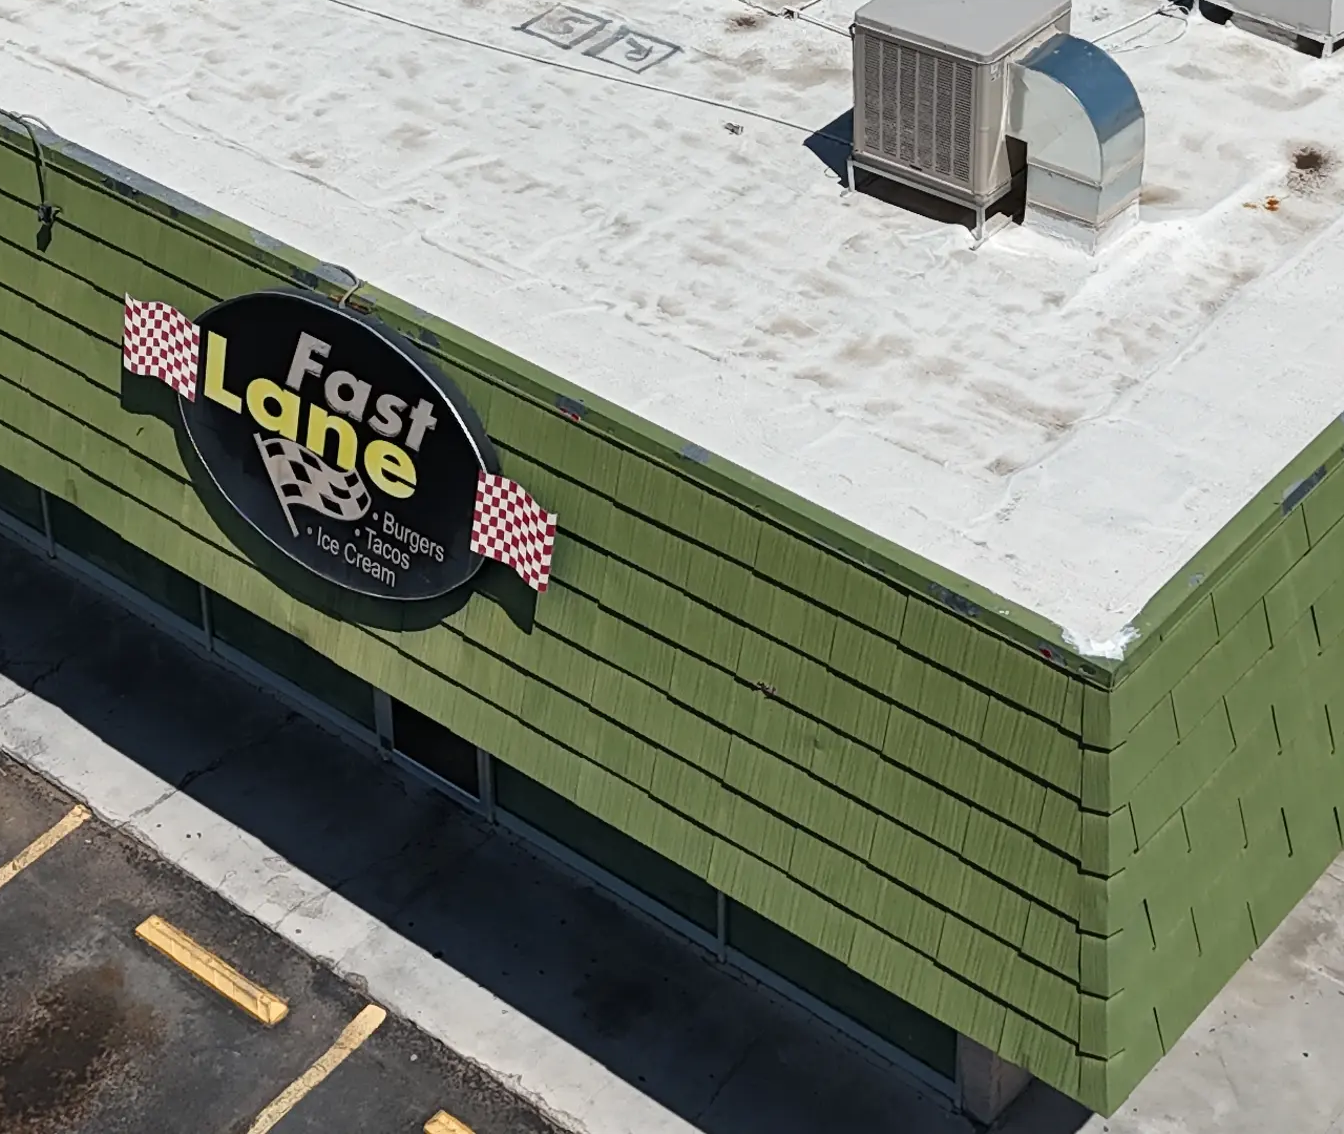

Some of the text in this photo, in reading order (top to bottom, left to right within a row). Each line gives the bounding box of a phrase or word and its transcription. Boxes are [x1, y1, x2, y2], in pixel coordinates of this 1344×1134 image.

[202, 330, 418, 499] Lane
[284, 331, 438, 452] Fast
[316, 526, 396, 587] Ice Cream
[364, 526, 411, 570] Tacos
[382, 511, 445, 563] Burgers
